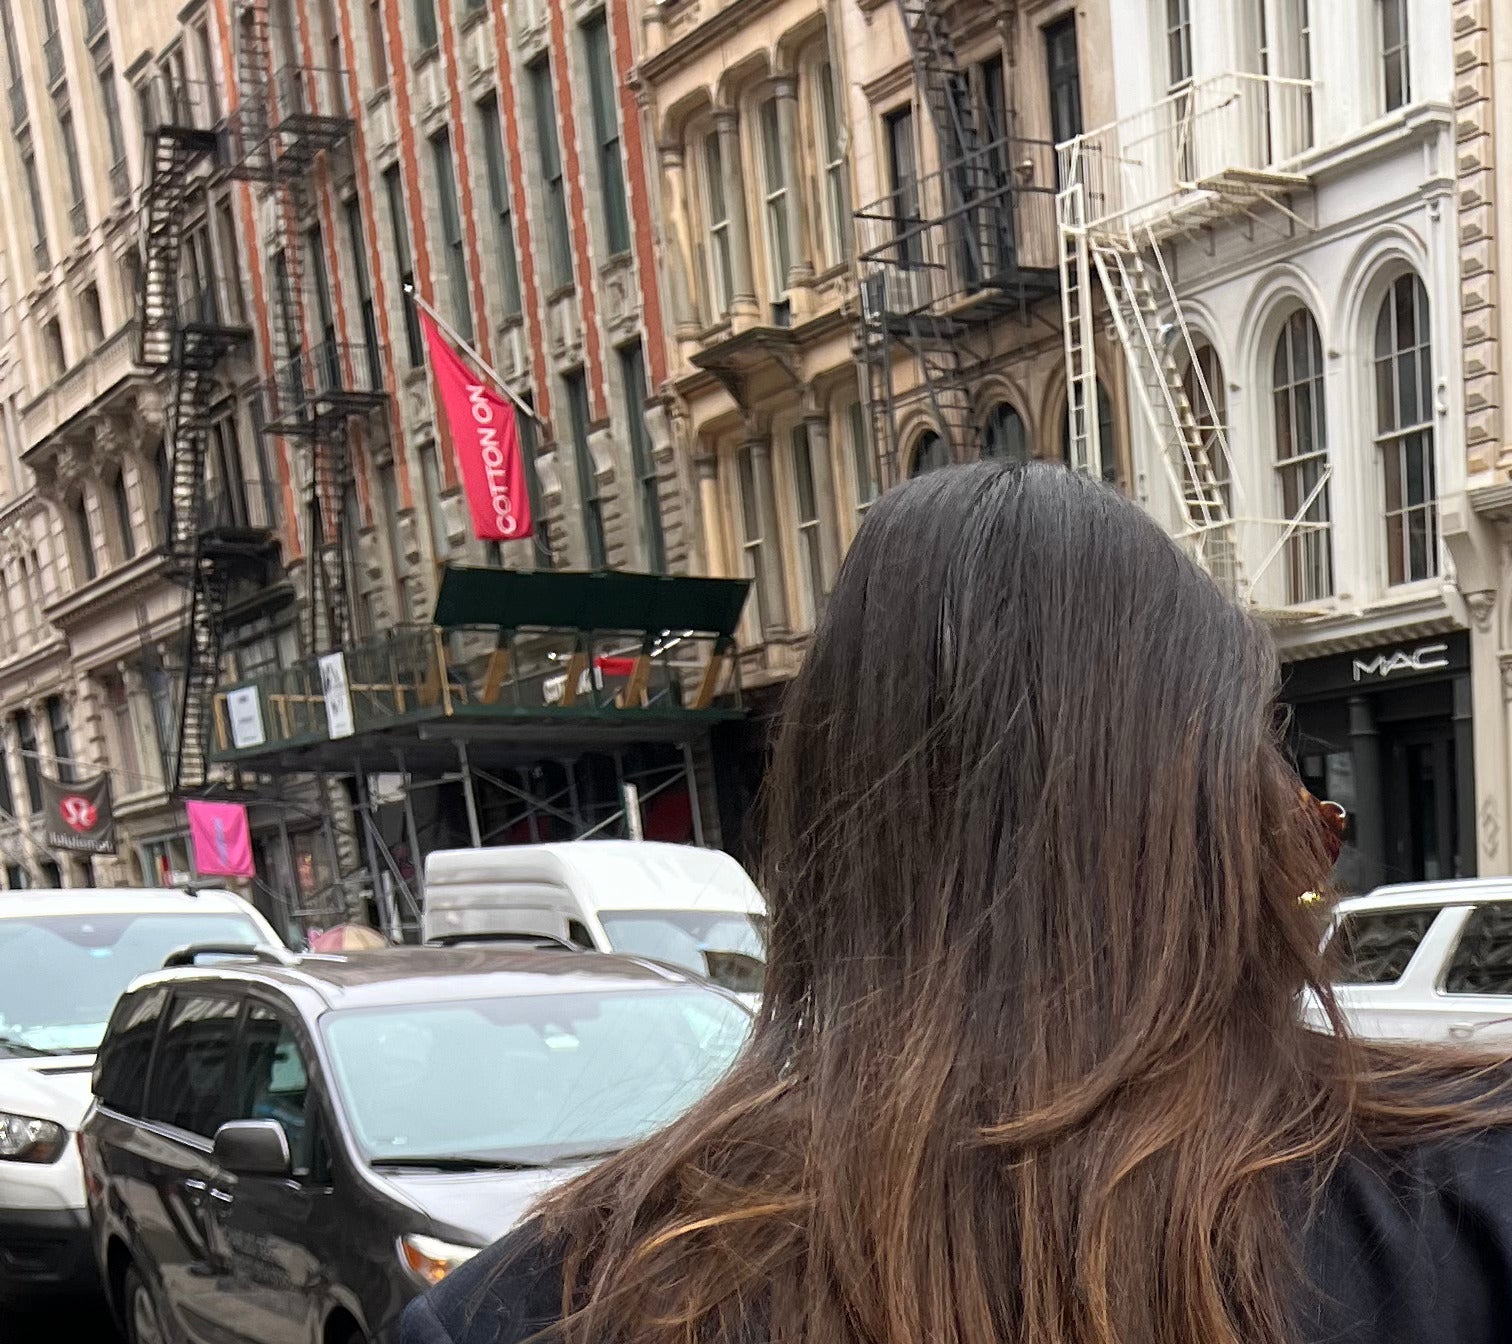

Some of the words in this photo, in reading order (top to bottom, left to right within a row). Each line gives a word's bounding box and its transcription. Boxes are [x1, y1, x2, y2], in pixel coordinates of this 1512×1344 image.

[465, 384, 493, 424] ON
[477, 428, 517, 534] COTTON
[1353, 644, 1449, 681] MAC
